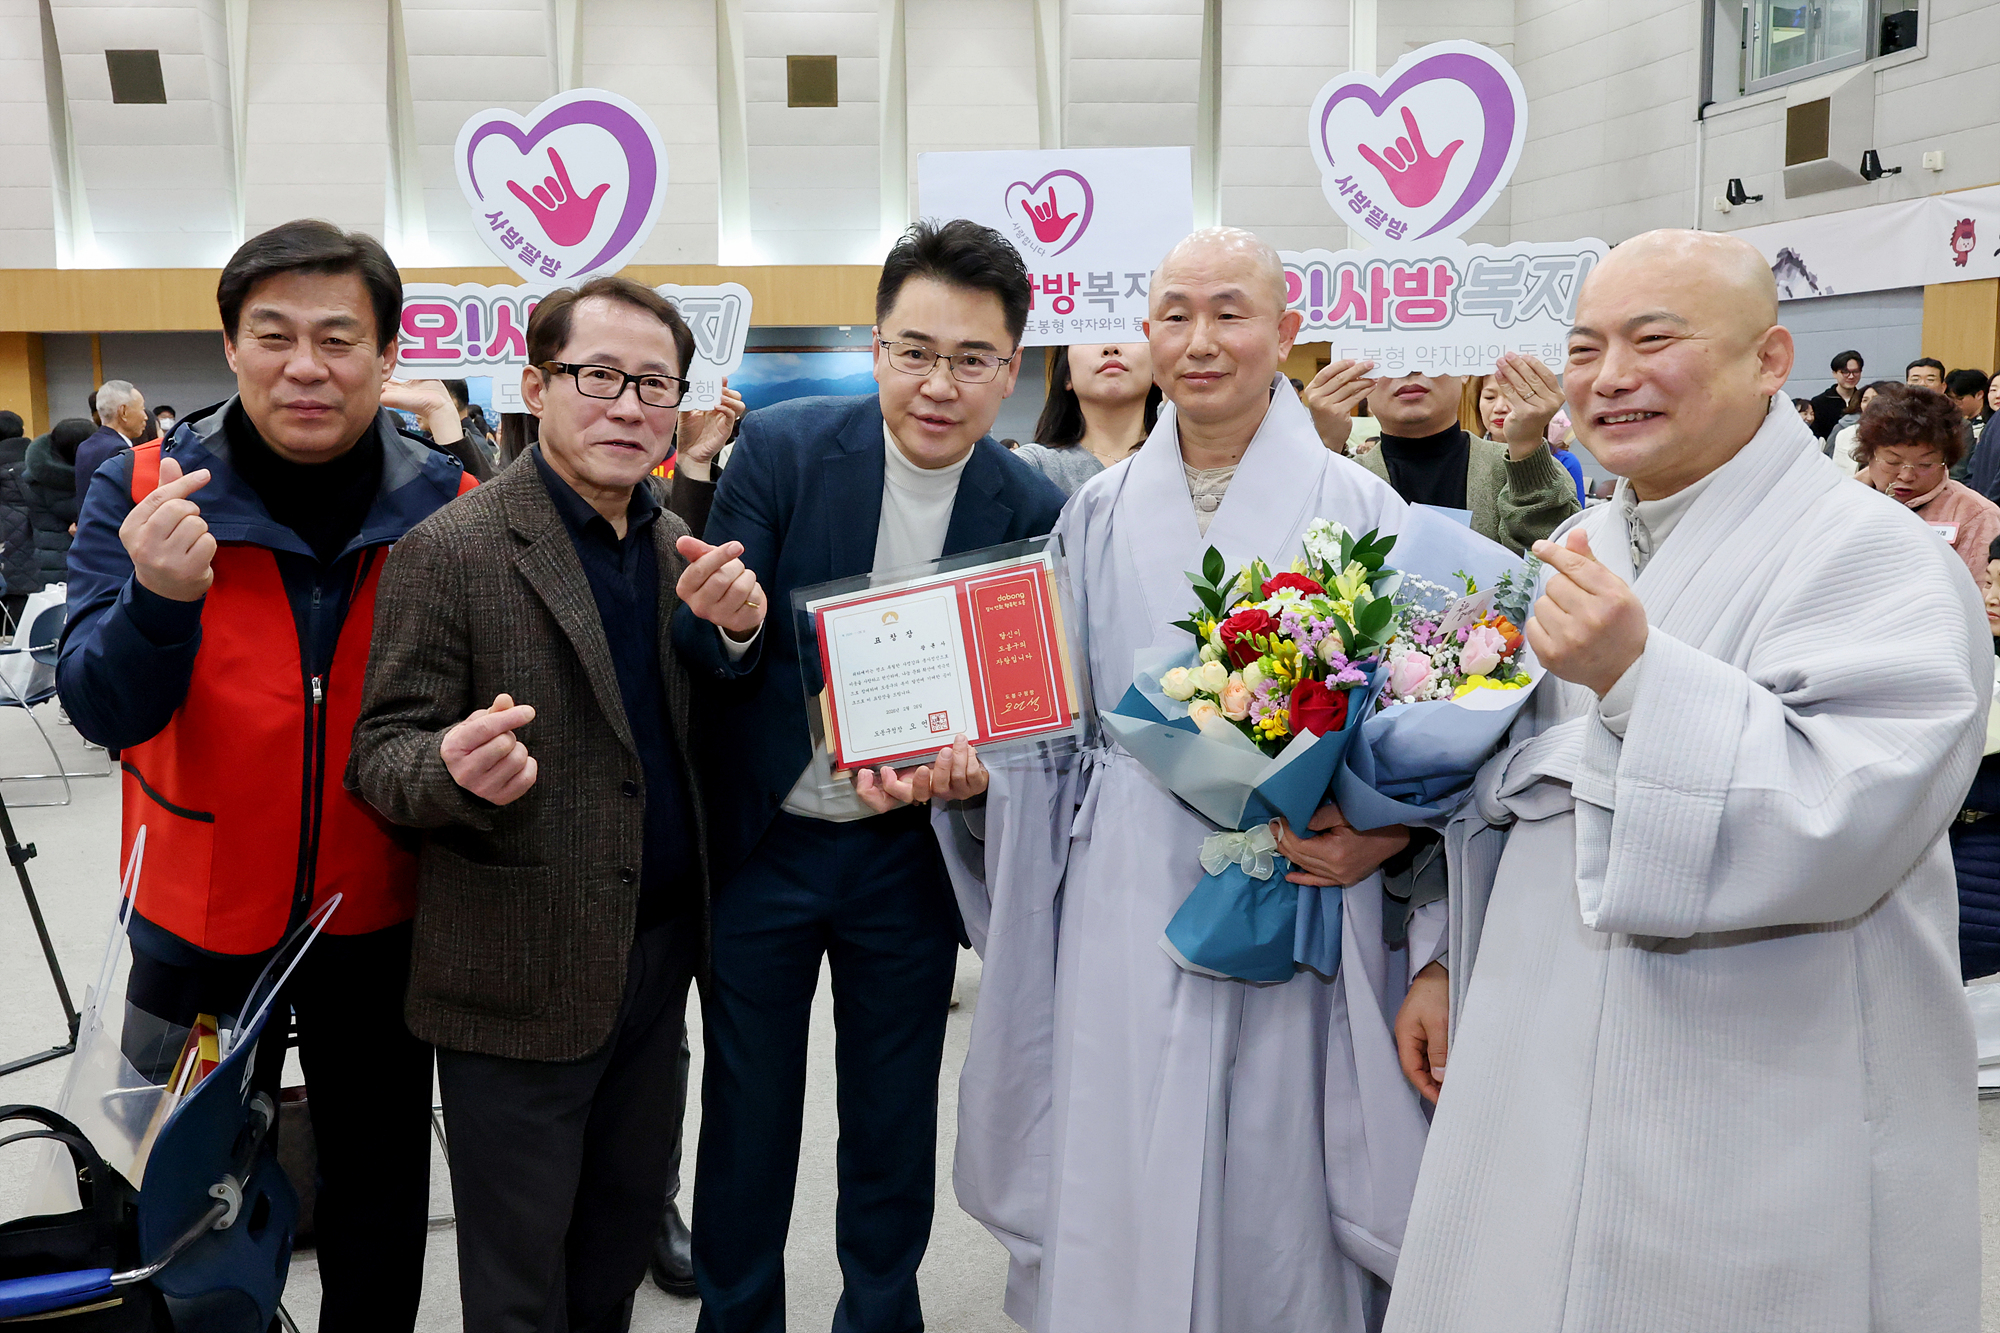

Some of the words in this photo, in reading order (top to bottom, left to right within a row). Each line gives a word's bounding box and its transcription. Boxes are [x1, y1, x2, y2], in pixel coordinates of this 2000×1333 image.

[1335, 175, 1408, 241] 사방팔방
[485, 210, 562, 278] 사방팔방
[1012, 222, 1046, 257] 사랑합니다
[1071, 317, 1125, 333] 약자와의
[1416, 345, 1505, 368] 약자와의
[997, 592, 1025, 602] dobong
[998, 628, 1021, 640] 당신이
[998, 640, 1026, 652] 도봉구의
[996, 652, 1033, 666] 자랑입니다
